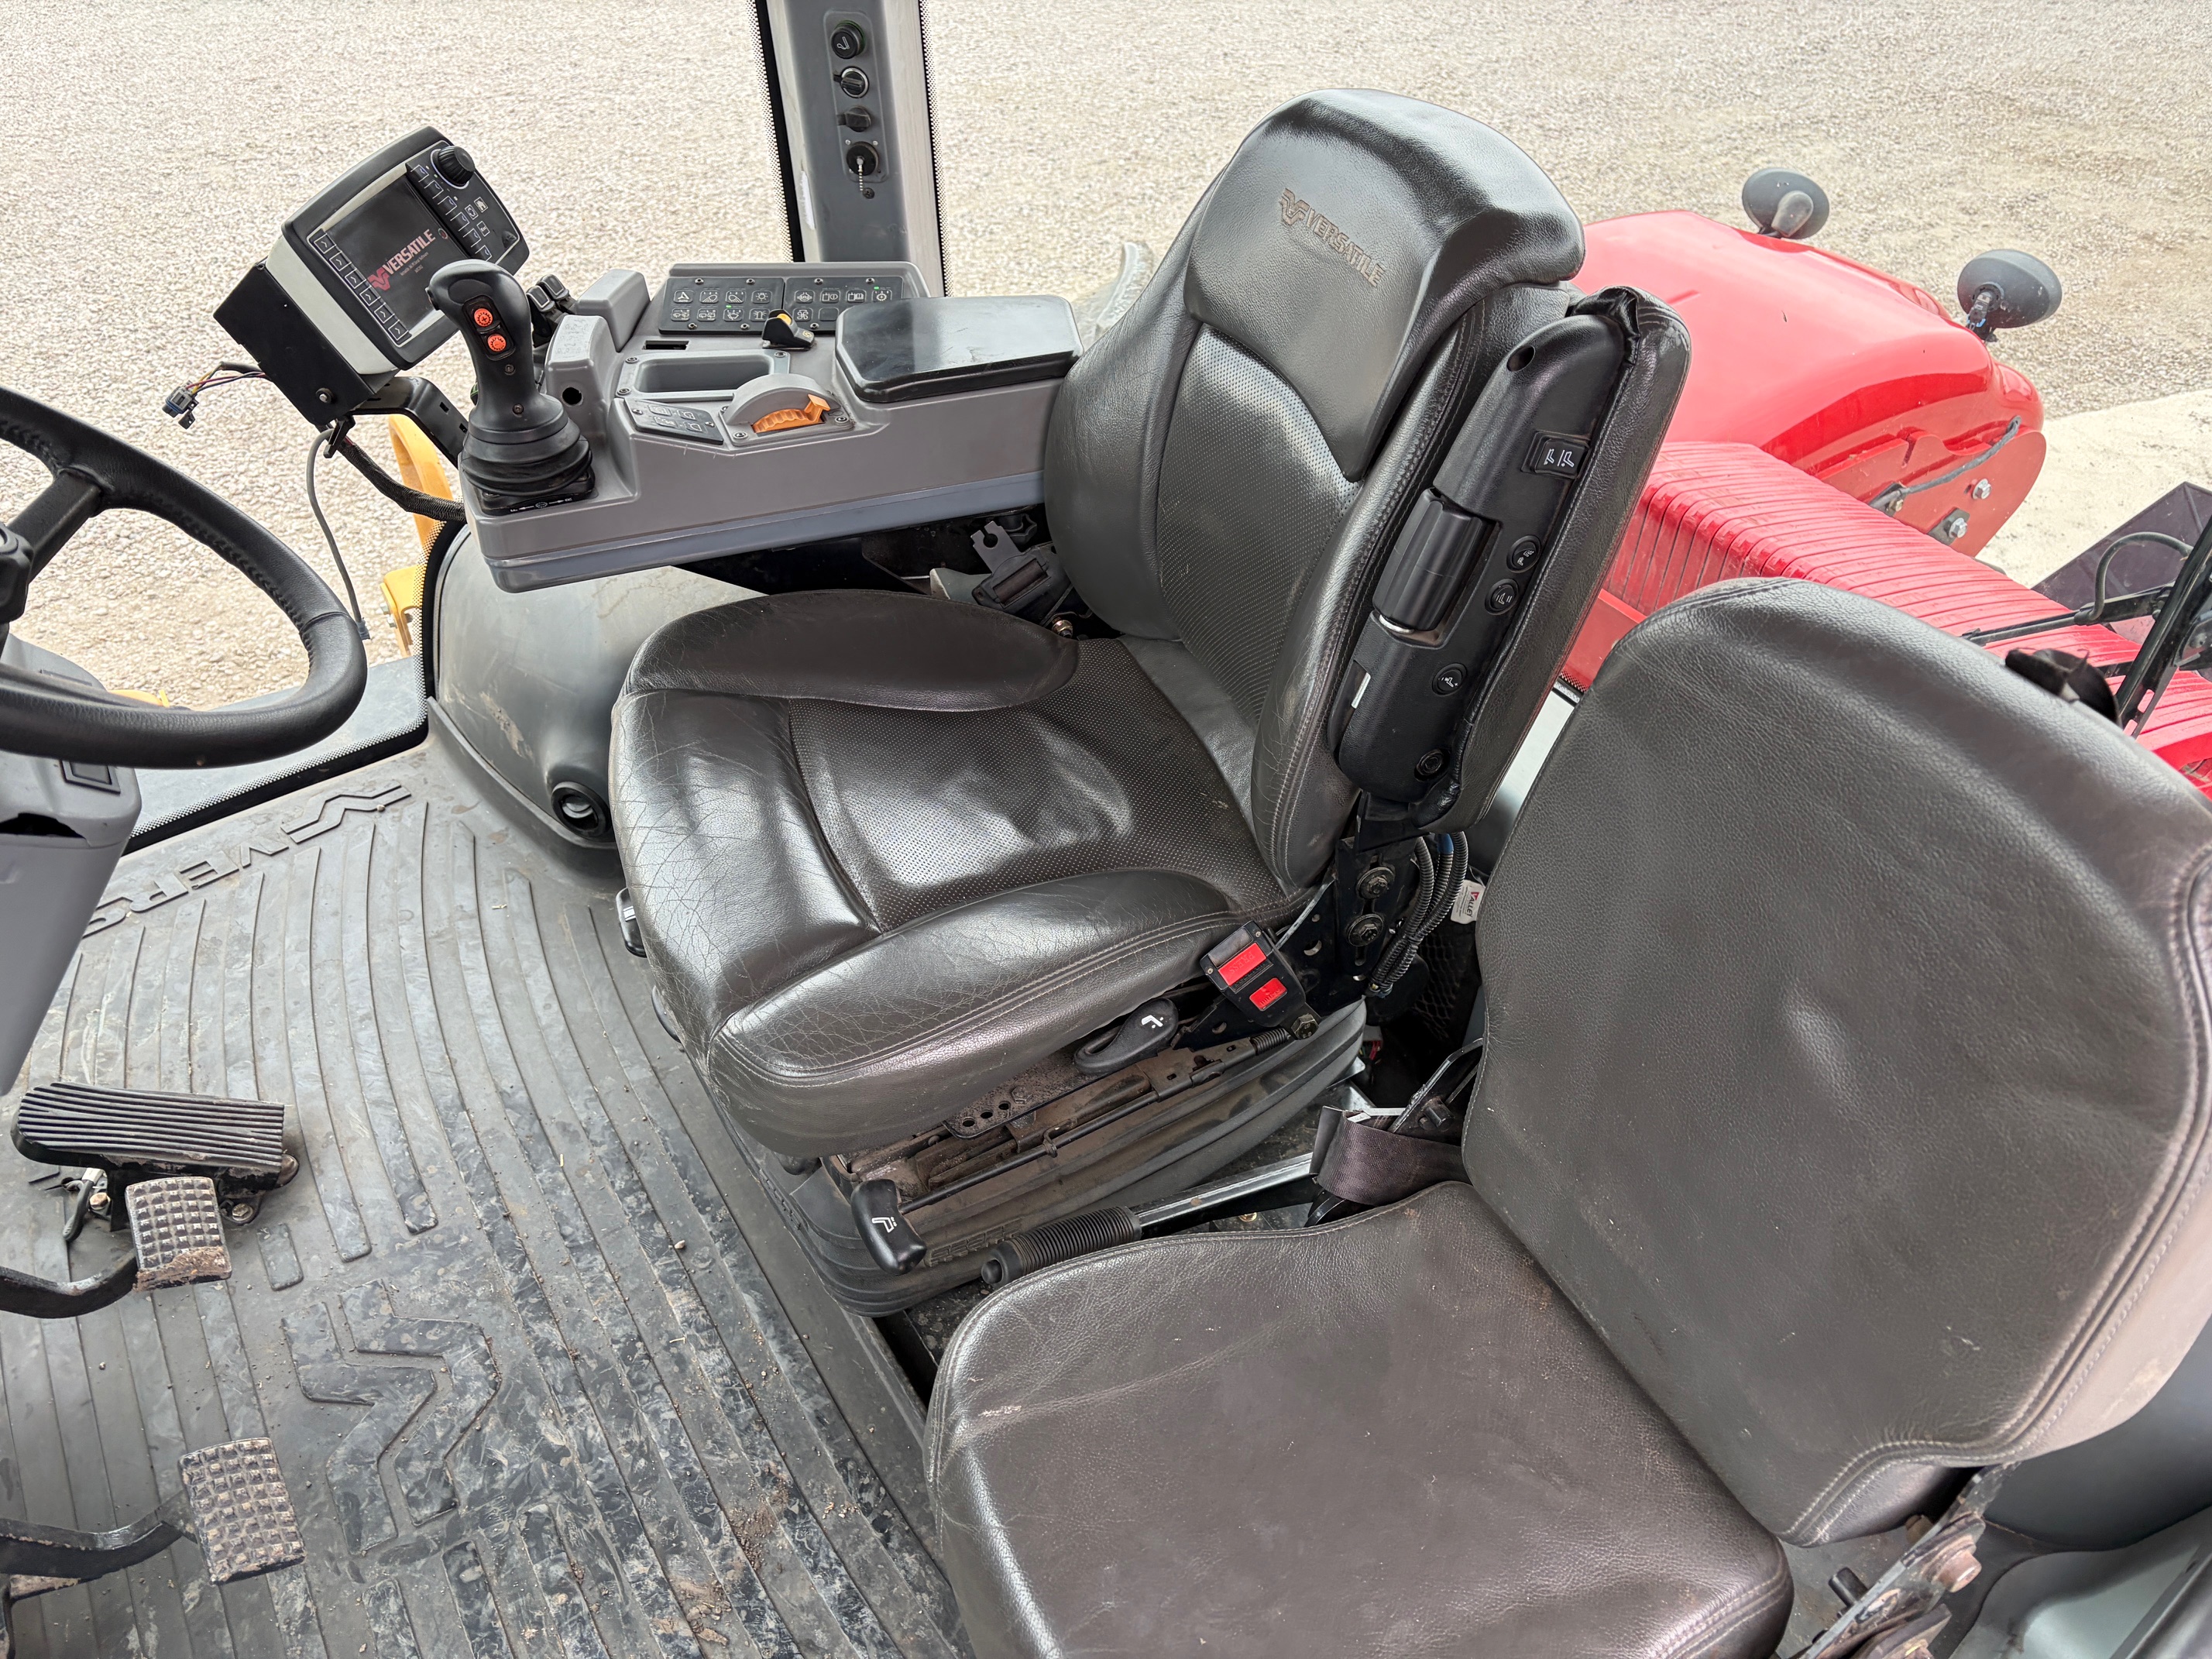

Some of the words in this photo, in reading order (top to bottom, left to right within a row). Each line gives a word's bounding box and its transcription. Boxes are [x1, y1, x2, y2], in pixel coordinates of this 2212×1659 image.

[382, 228, 436, 275] VERSATILE
[1306, 208, 1386, 288] VERSATILE
[1229, 951, 1255, 974] PRESS
